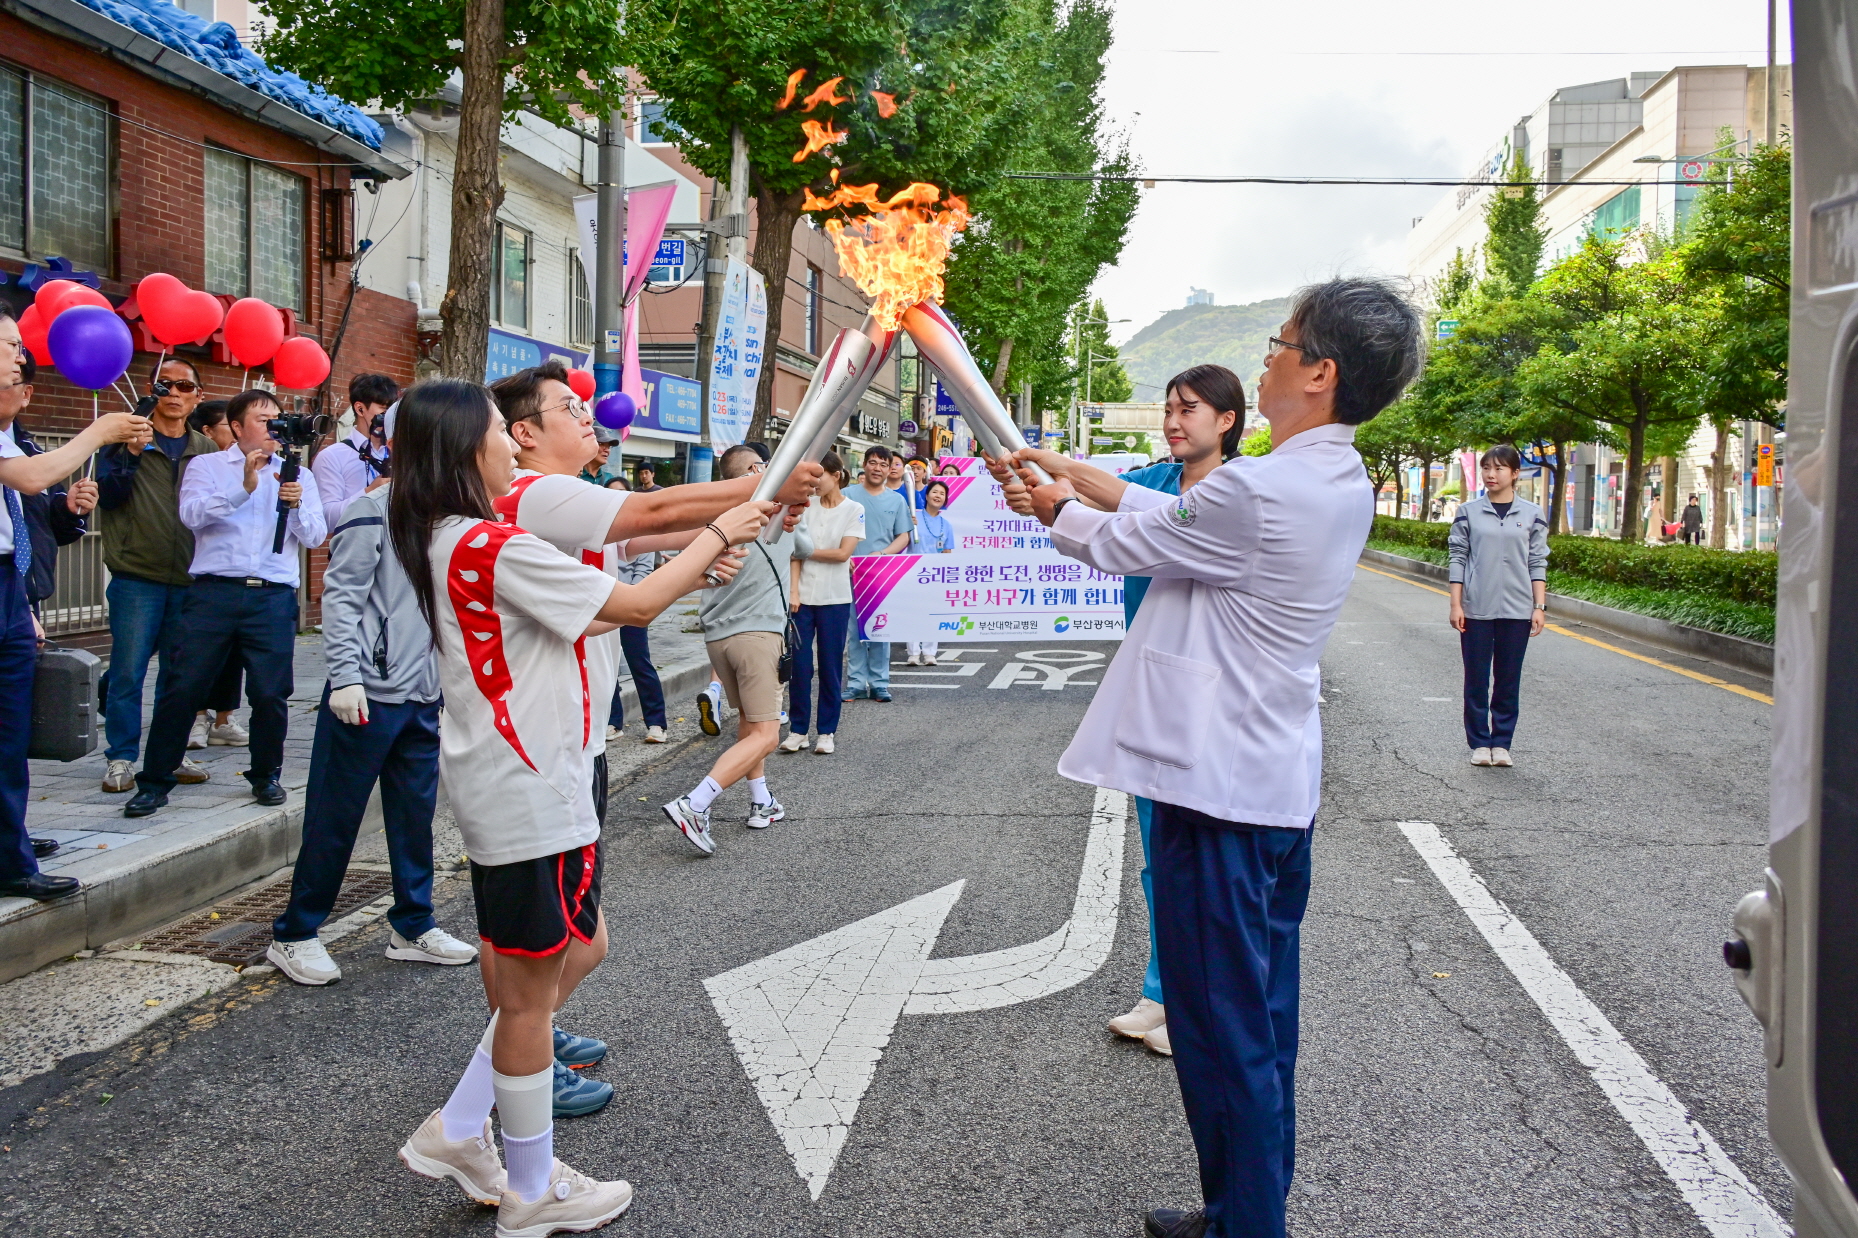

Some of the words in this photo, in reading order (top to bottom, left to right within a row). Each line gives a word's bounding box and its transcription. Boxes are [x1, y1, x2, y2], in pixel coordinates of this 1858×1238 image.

[962, 536, 1025, 549] 전국체전과
[917, 564, 961, 584] 승리를
[964, 564, 995, 583] 향한
[998, 564, 1033, 583] 도전,
[1037, 564, 1082, 583] 생명을
[945, 589, 979, 607] 부산
[984, 588, 1036, 606] 서구가
[1042, 587, 1077, 606] 함께
[978, 620, 1038, 631] 부산대학교병원
